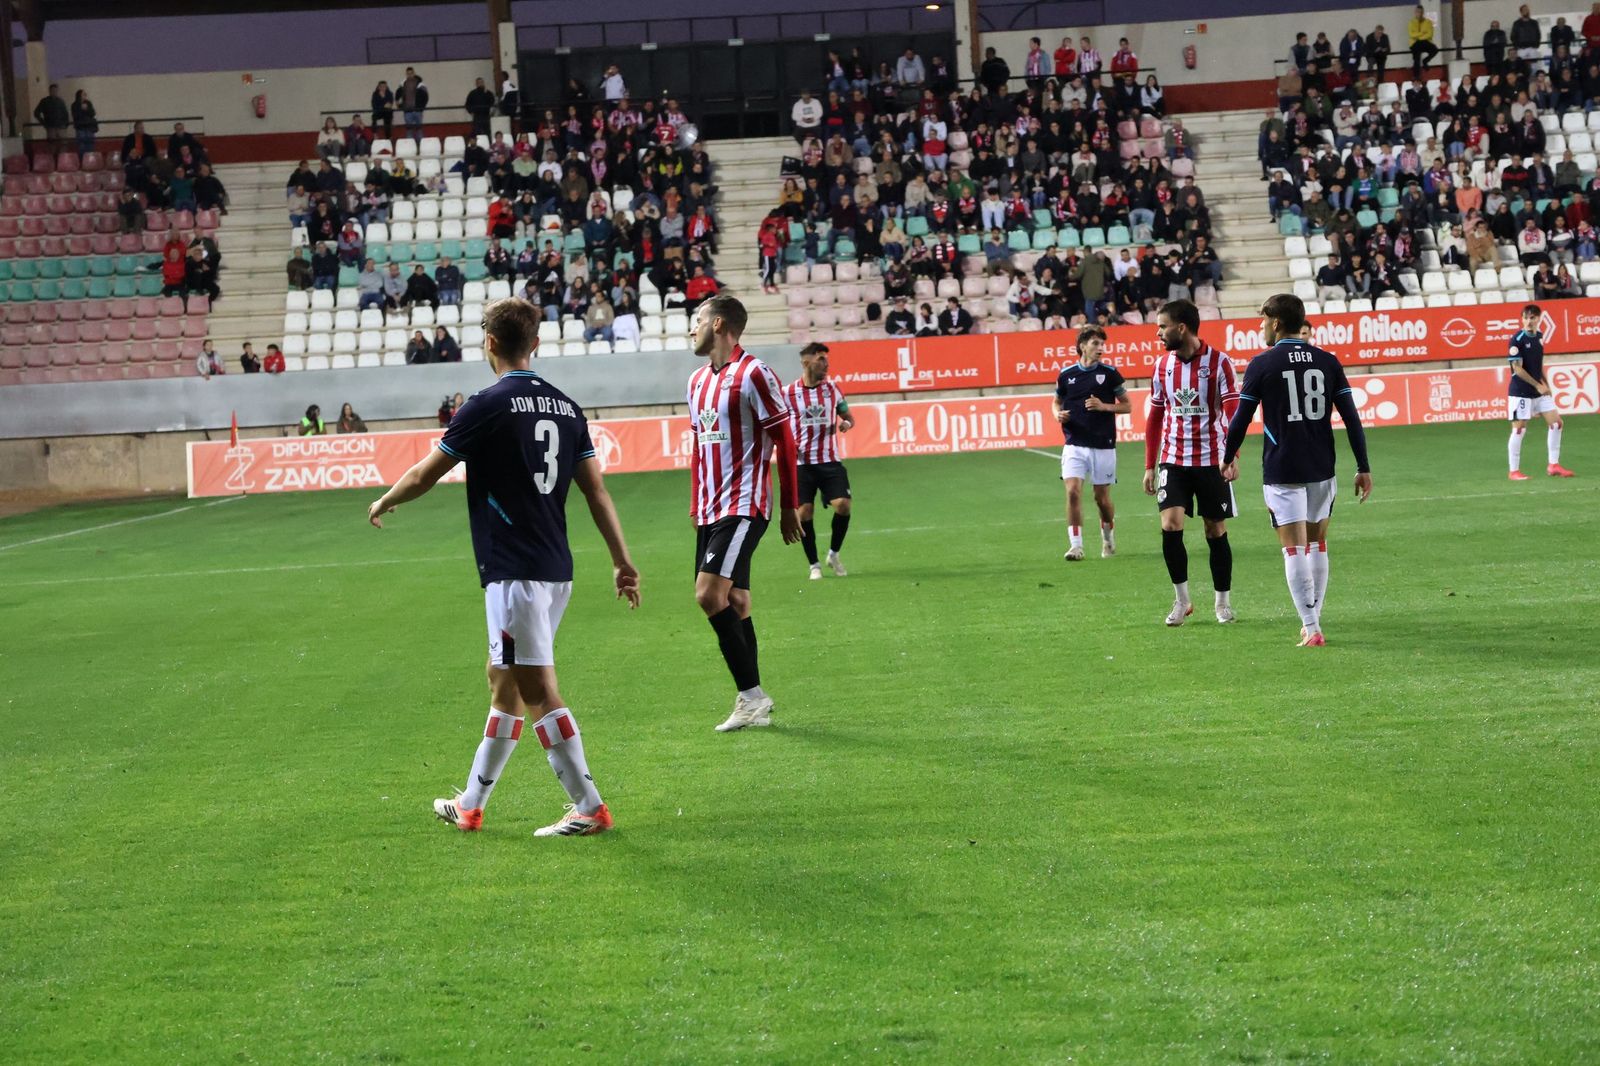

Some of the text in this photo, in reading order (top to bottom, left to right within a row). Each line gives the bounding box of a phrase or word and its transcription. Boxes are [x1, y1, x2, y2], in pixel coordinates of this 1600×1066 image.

[1577, 314, 1600, 325] Grup
[1359, 313, 1428, 342] Atilano
[1440, 328, 1476, 336] NISSAN
[1578, 325, 1600, 336] Leo
[1044, 340, 1165, 358] RESURANT
[1359, 346, 1428, 358] 607 489 002
[1102, 355, 1136, 368] DEL
[1289, 352, 1313, 363] EDER
[827, 368, 978, 383] LA FÁBRICA DE LA LUZ
[1282, 368, 1326, 422] 18
[510, 396, 577, 418] JON DE LUIS
[1455, 398, 1506, 410] Junta de
[1520, 399, 1526, 410] 9
[1423, 408, 1507, 423] Castilla y León
[878, 403, 1044, 452] La Opinión
[1123, 430, 1146, 440] Cor
[661, 419, 694, 457] La
[272, 438, 375, 457] DIPUTACIÓN
[892, 438, 1026, 454] El Correo de Zamora
[534, 420, 560, 494] 3
[264, 463, 385, 490] ZAMORA
